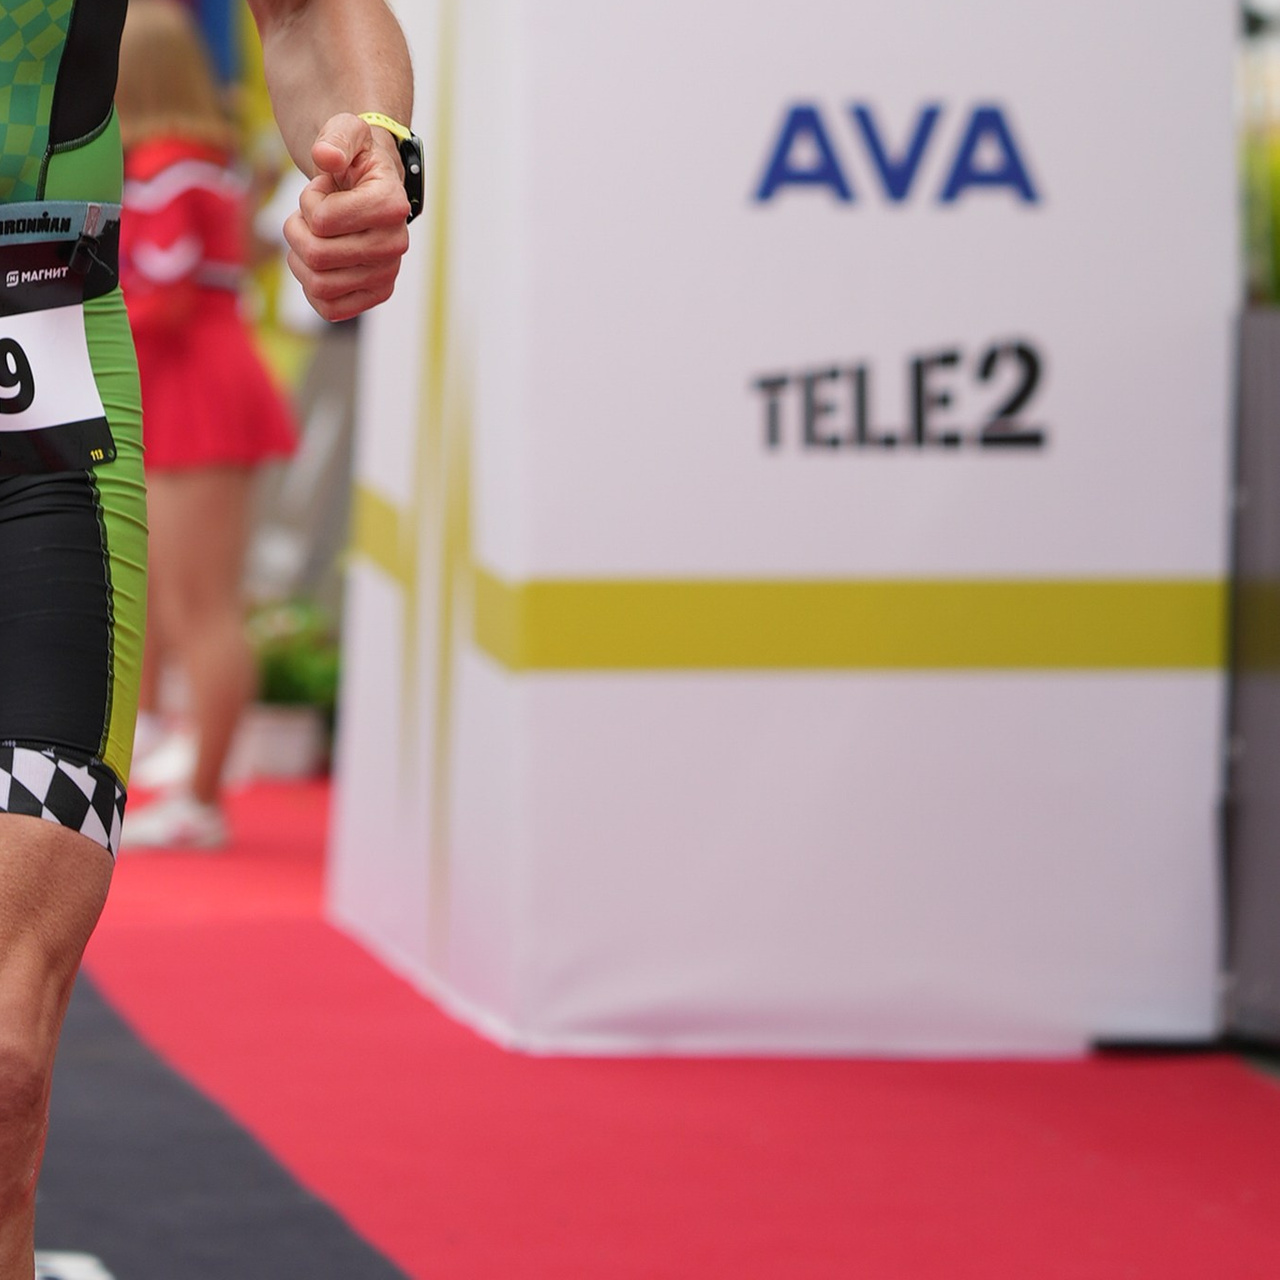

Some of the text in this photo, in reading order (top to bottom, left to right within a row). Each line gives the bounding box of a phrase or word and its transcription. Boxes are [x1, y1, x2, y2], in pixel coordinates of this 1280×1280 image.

[750, 101, 1041, 206] AVA
[21, 266, 69, 283] МАГНИТ
[751, 335, 1049, 451] TELE2
[90, 448, 104, 461] 113
